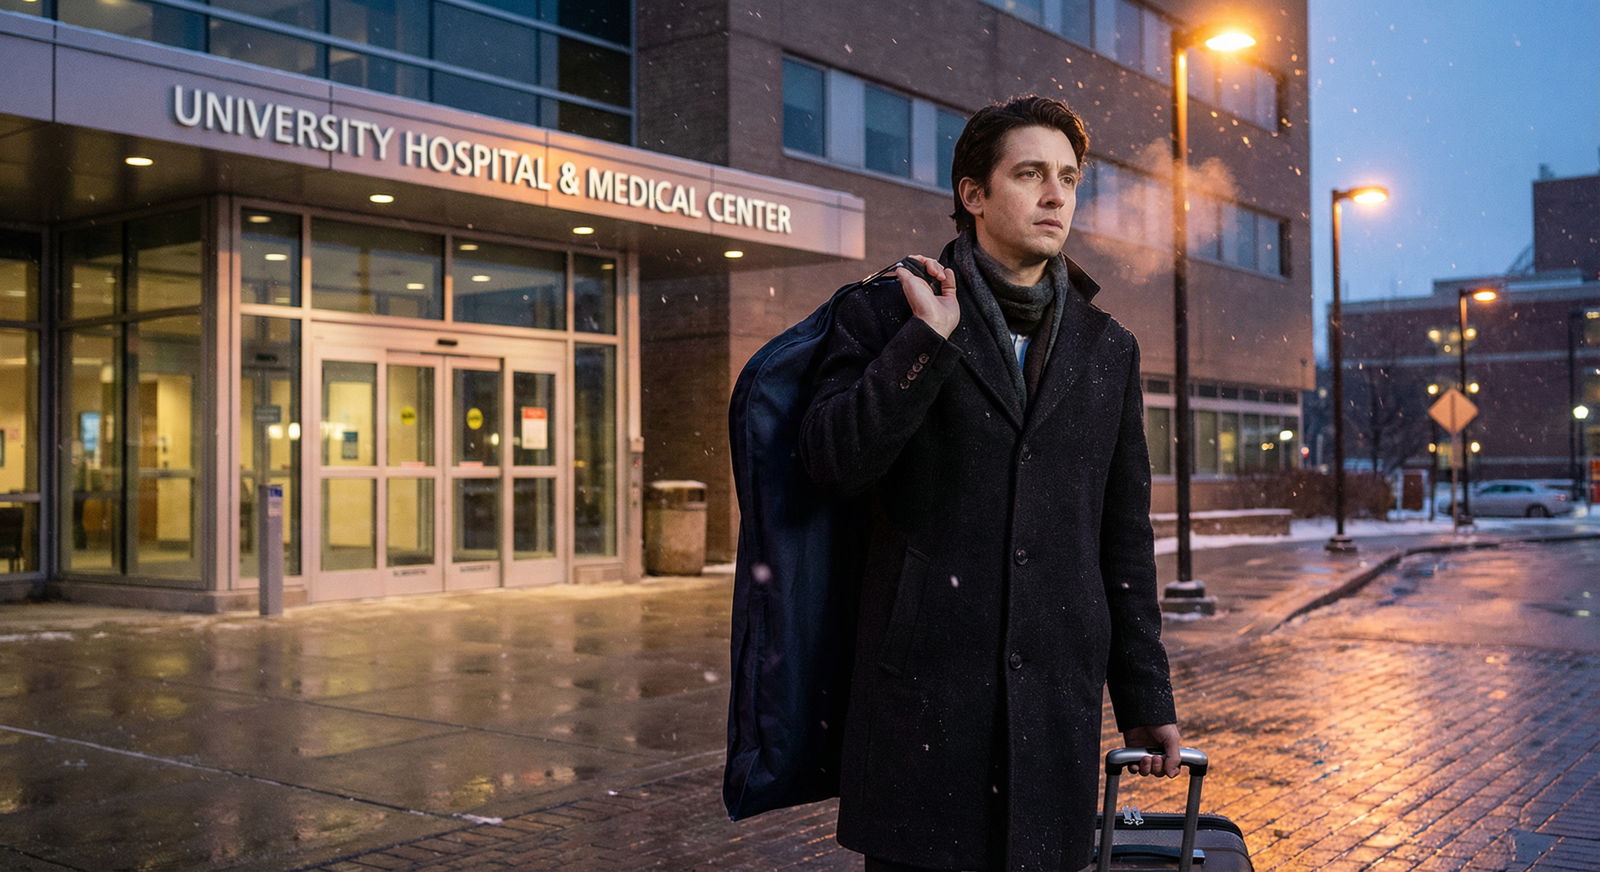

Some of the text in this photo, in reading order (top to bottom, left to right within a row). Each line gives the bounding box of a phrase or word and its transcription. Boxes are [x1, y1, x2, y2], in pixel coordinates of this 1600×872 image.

[174, 85, 792, 233] UNIVERSITY HOSPITAL & MEDICAL CENTER
